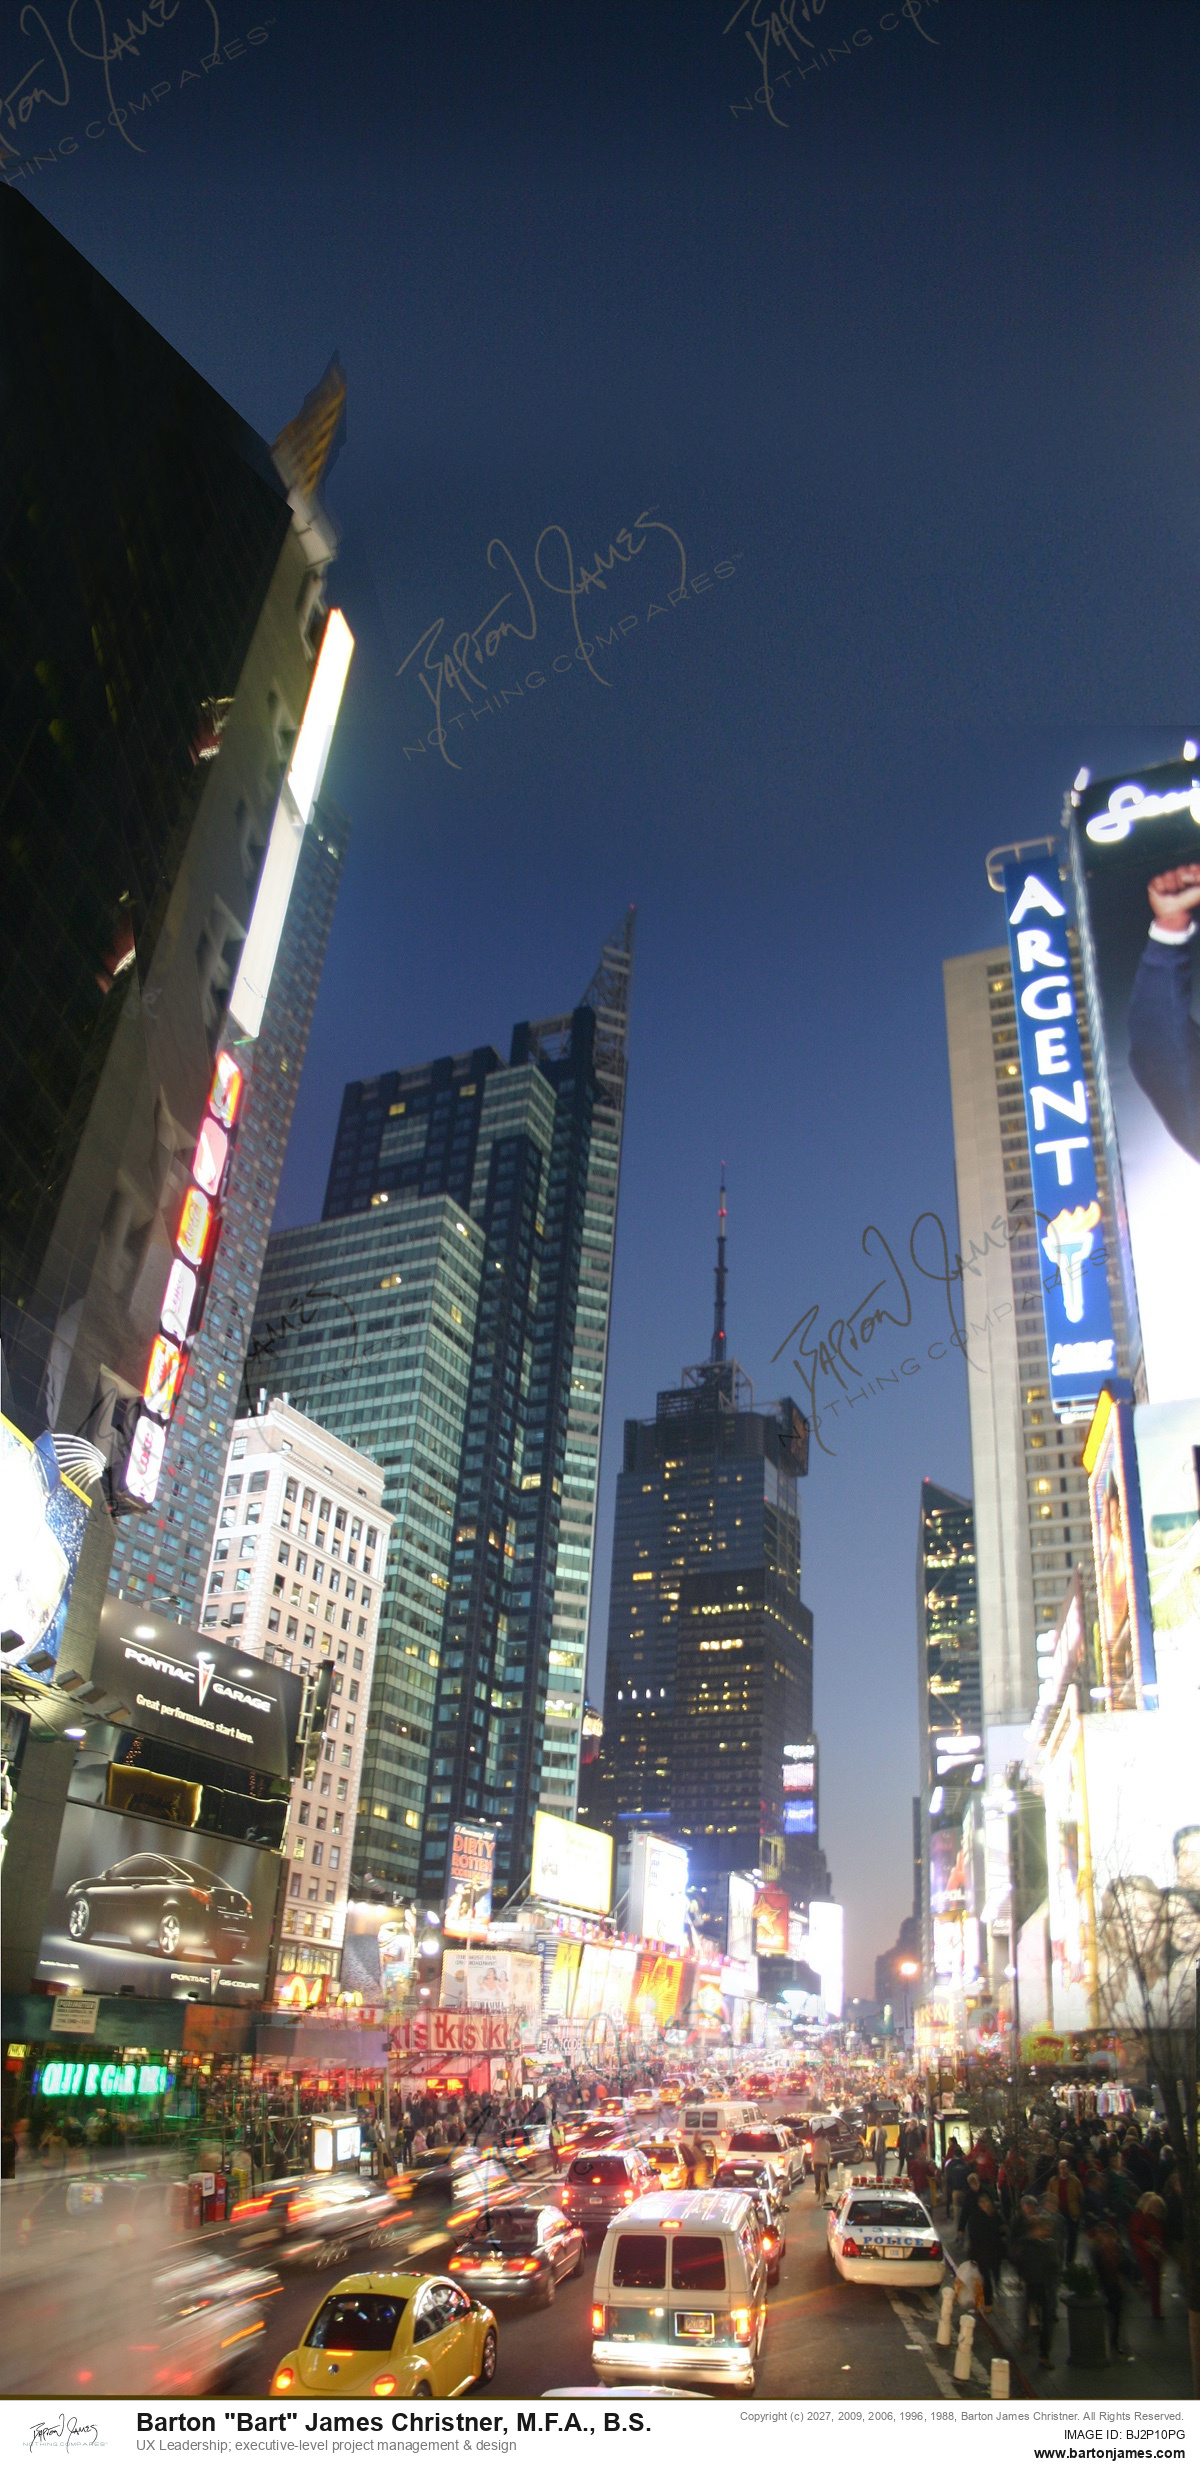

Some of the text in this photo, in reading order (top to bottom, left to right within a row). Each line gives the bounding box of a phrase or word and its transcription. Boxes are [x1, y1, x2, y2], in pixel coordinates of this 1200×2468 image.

[1008, 875, 1091, 1187] ARGENT
[125, 1647, 271, 1713] PONTIAC GARAGE
[136, 1693, 160, 1711] Great
[160, 1703, 215, 1731] performances
[215, 1723, 235, 1738] start
[453, 1834, 496, 1859] DIRTY
[451, 1852, 493, 1873] ROTTEN
[170, 1973, 210, 1984] PONTIAC
[863, 2236, 924, 2247] POLICE
